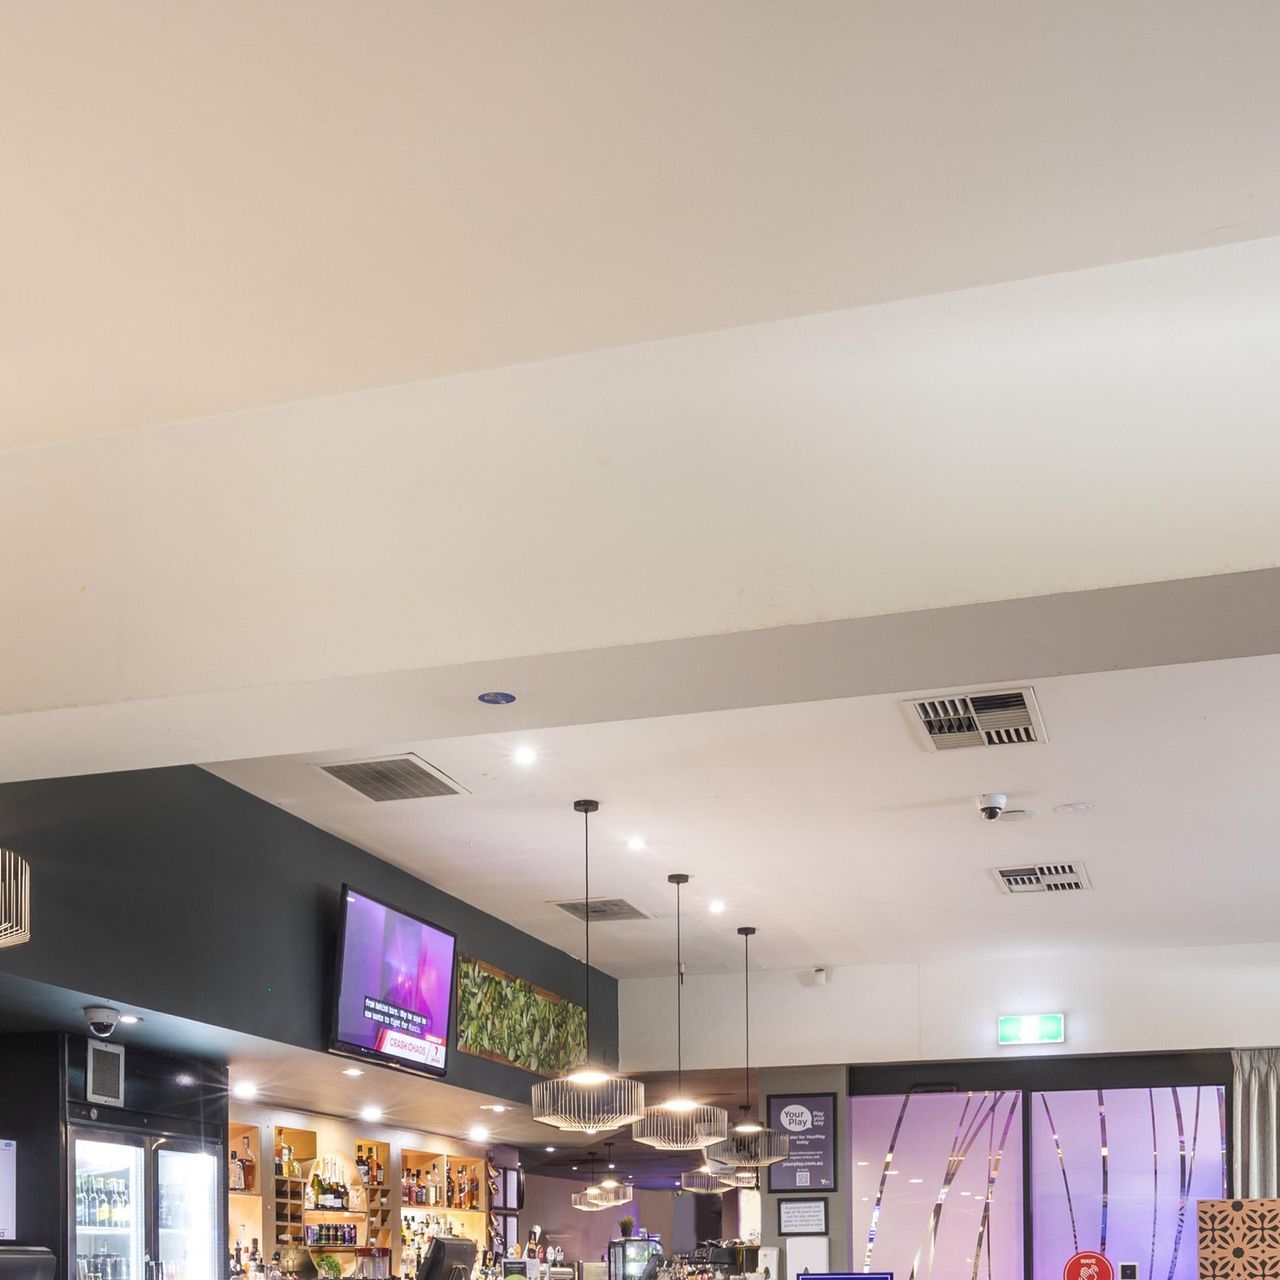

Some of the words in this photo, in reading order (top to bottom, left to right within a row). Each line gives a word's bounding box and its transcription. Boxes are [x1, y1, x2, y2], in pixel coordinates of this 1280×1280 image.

[390, 1037, 407, 1050] CRASH
[407, 1042, 426, 1056] CHAOS
[789, 1119, 807, 1127] Play
